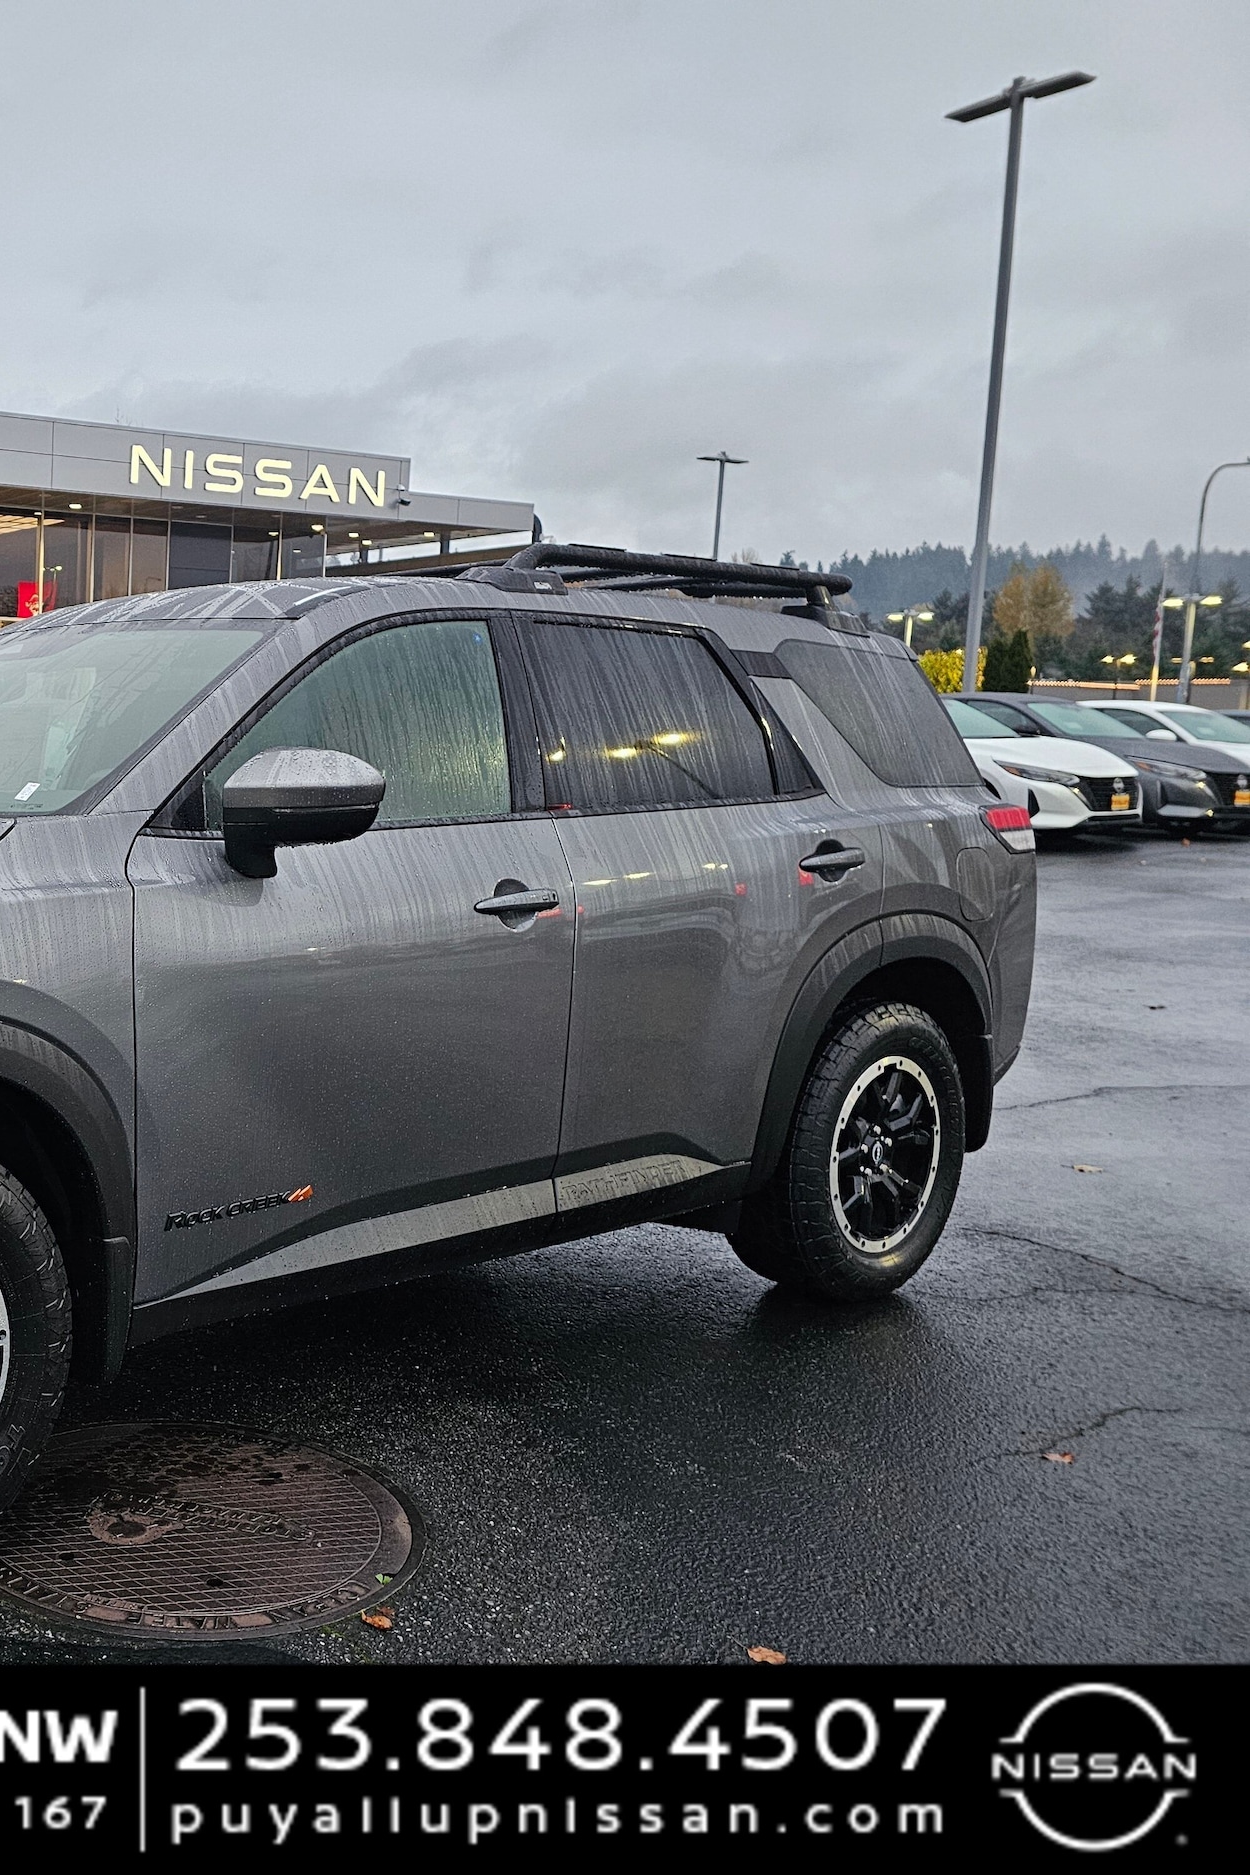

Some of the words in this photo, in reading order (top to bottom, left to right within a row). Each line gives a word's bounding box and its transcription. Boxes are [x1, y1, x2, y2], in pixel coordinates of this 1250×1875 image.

[129, 444, 386, 507] NISSAN
[163, 1204, 226, 1232] ROCK
[225, 1190, 292, 1218] CREEK
